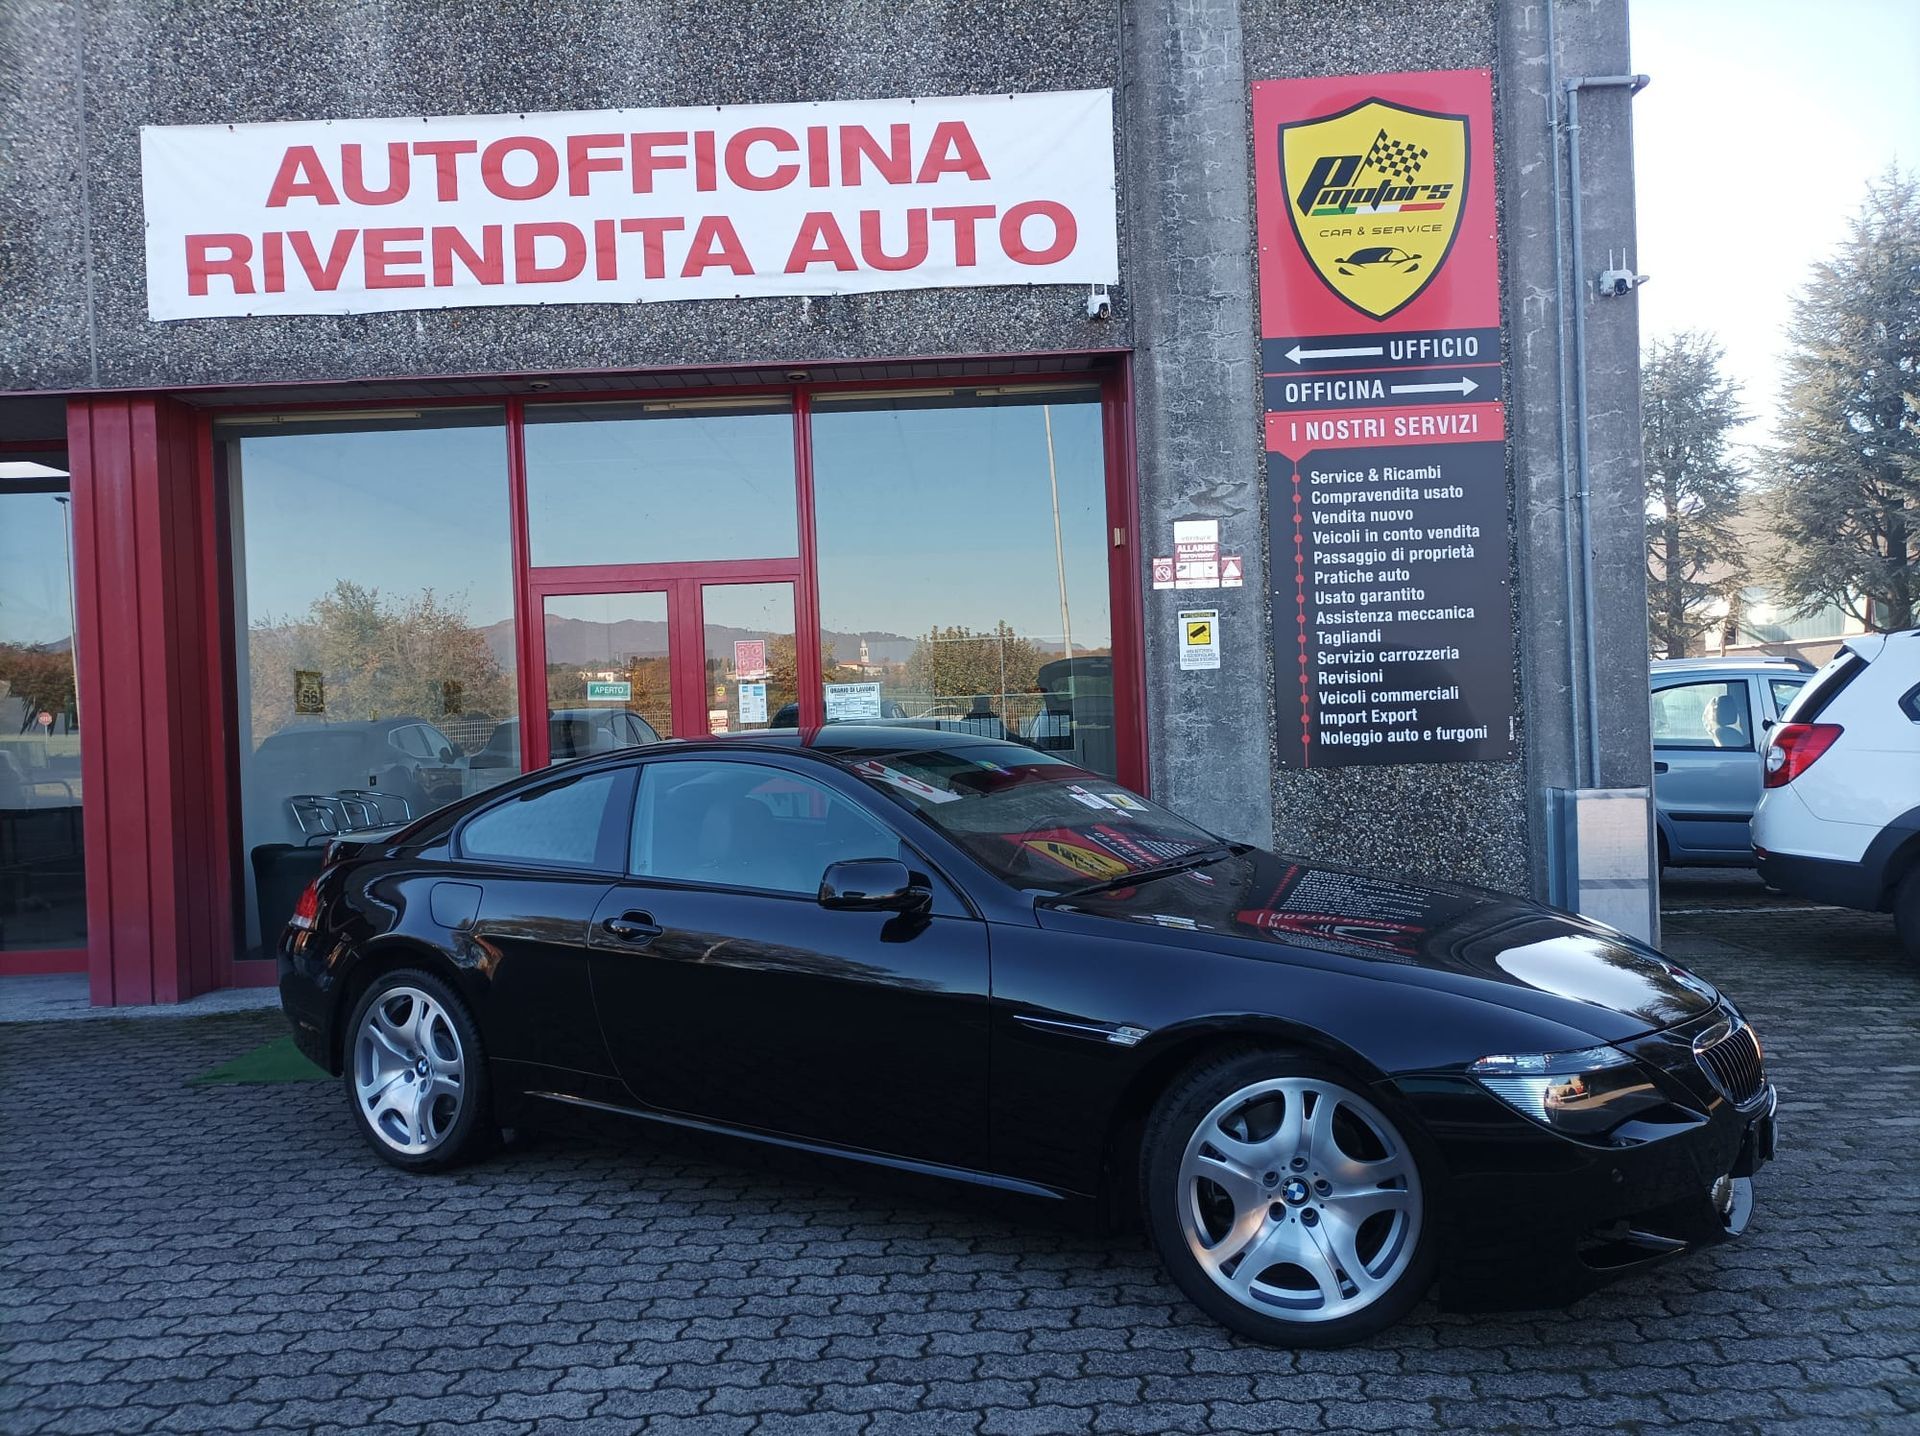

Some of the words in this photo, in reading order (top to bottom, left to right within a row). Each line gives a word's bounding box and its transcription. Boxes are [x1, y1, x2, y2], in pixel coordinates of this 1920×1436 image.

[266, 121, 990, 208] AUTOFFICINA
[1319, 227, 1353, 238] CAR
[1356, 226, 1366, 236] &
[1371, 223, 1444, 236] SERVICE
[185, 216, 754, 296] RIVENDITA
[784, 200, 1078, 275] AUTO
[1389, 336, 1480, 361] UFFICIO
[1284, 378, 1386, 404] OFFICINA
[1291, 423, 1297, 442] I
[1306, 418, 1386, 441] NOSTRI
[1394, 414, 1479, 437] SERVIZI
[1310, 469, 1364, 485] Service
[1368, 467, 1380, 482] &
[1383, 464, 1442, 481] Ricambi
[1311, 486, 1420, 506] Compravendita
[1423, 484, 1464, 500] usato
[1311, 509, 1366, 525] Vendita
[1370, 509, 1414, 522] nuovo
[1312, 529, 1360, 545] Veicoli
[1364, 529, 1379, 543] in
[1382, 528, 1423, 542] conto
[1426, 524, 1480, 541] vendita
[1313, 549, 1387, 567] Passaggio
[1391, 547, 1405, 563] di
[1408, 543, 1476, 564] proprietà
[1314, 569, 1374, 585] Pratiche
[1378, 567, 1410, 582] auto
[1314, 590, 1356, 606] Usato
[1359, 586, 1425, 605] garantito
[1315, 609, 1393, 625] Assistenza
[1397, 605, 1475, 622] meccanica
[1316, 628, 1382, 647] Tagliandi
[1317, 649, 1375, 665] Servizio
[1379, 645, 1460, 663] carrozzeria
[1318, 669, 1384, 685] Revisioni
[594, 686, 624, 694] APERTO
[1318, 689, 1366, 705] Veicoli
[1370, 685, 1459, 703] commerciali
[1320, 710, 1368, 727] Import
[1371, 708, 1418, 726] Export
[1320, 729, 1383, 747] Noleggio
[1387, 728, 1419, 743] auto
[1423, 730, 1432, 741] e
[1435, 724, 1488, 743] furgoni
